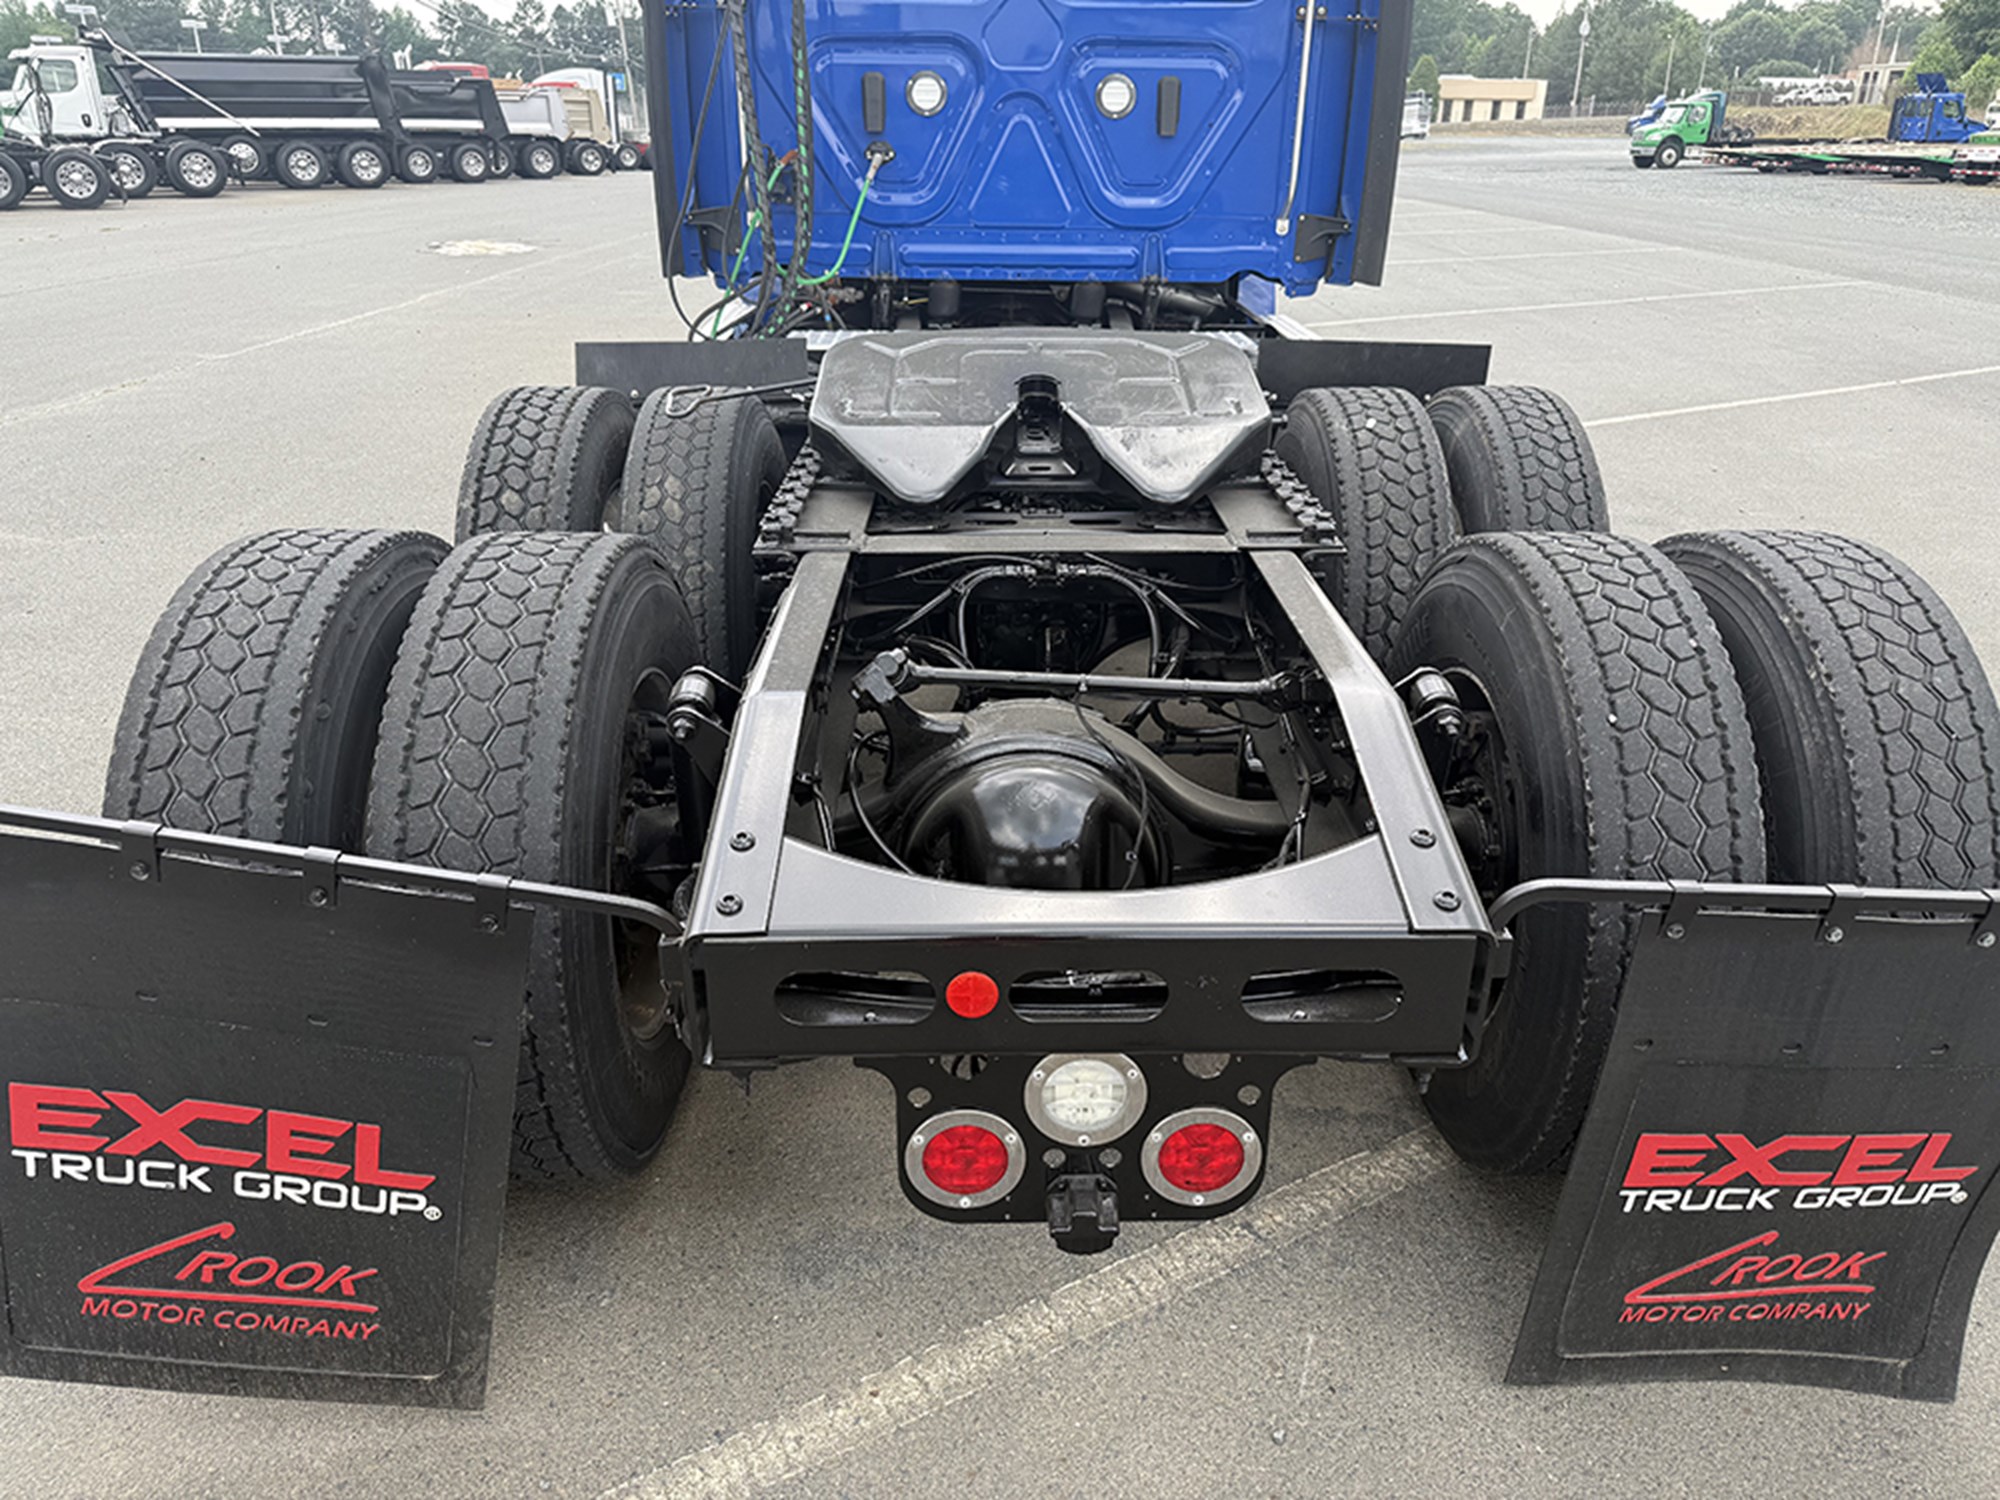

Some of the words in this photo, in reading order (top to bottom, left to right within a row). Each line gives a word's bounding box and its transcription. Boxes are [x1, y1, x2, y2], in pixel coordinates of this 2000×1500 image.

[8, 1082, 436, 1190] EXCEL
[11, 1149, 212, 1193] TRUCK
[1622, 1133, 1979, 1187] EXCEL
[1619, 1187, 1781, 1213] TRUCK
[79, 1297, 206, 1326] MOTOR
[213, 1310, 380, 1340] COMPANY
[1618, 1306, 1725, 1324] MOTOR
[1728, 1303, 1871, 1323] COMPANY
